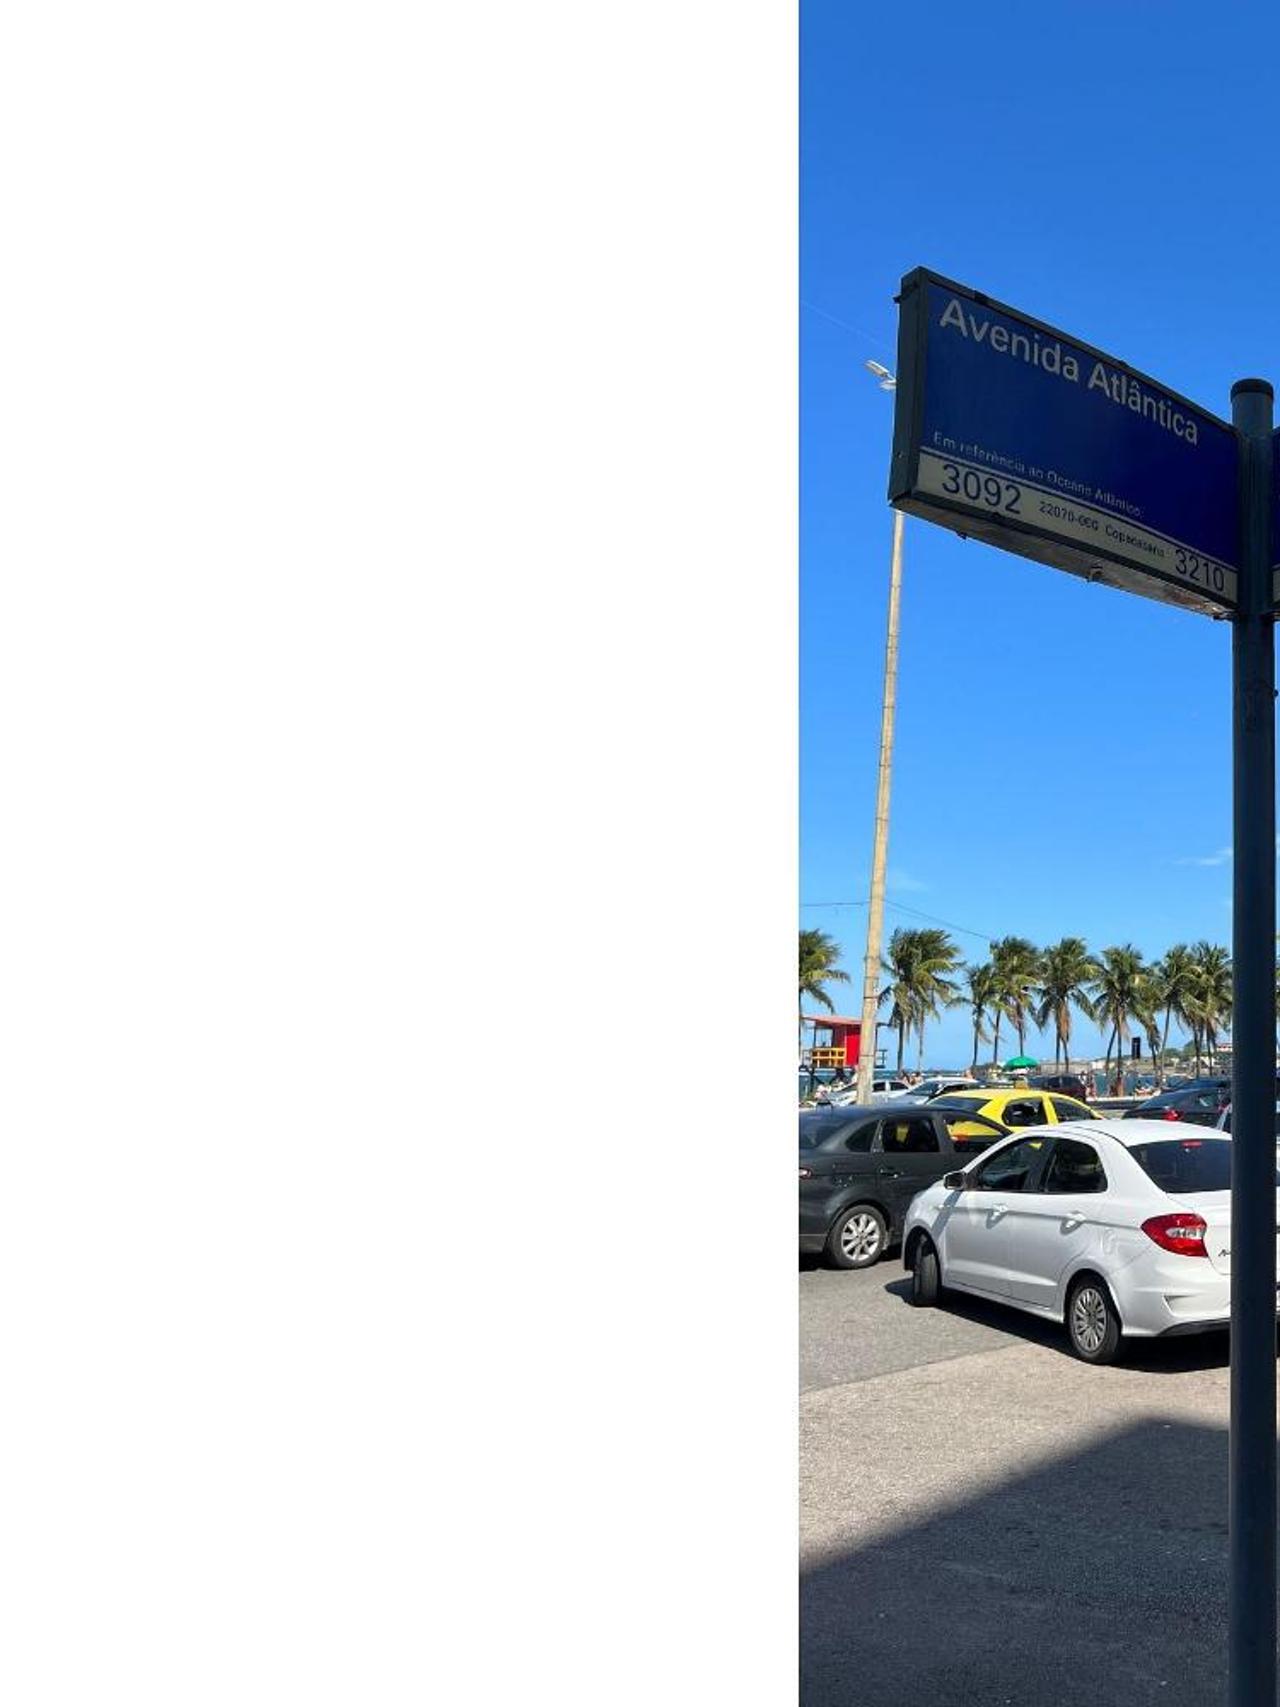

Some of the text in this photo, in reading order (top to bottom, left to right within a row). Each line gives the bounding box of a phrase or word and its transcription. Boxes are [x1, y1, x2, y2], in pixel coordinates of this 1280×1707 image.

[940, 299, 1199, 445] Avenida Atlântica
[934, 431, 955, 450] Em
[942, 464, 1020, 514] 3092
[1175, 549, 1225, 592] 3210
